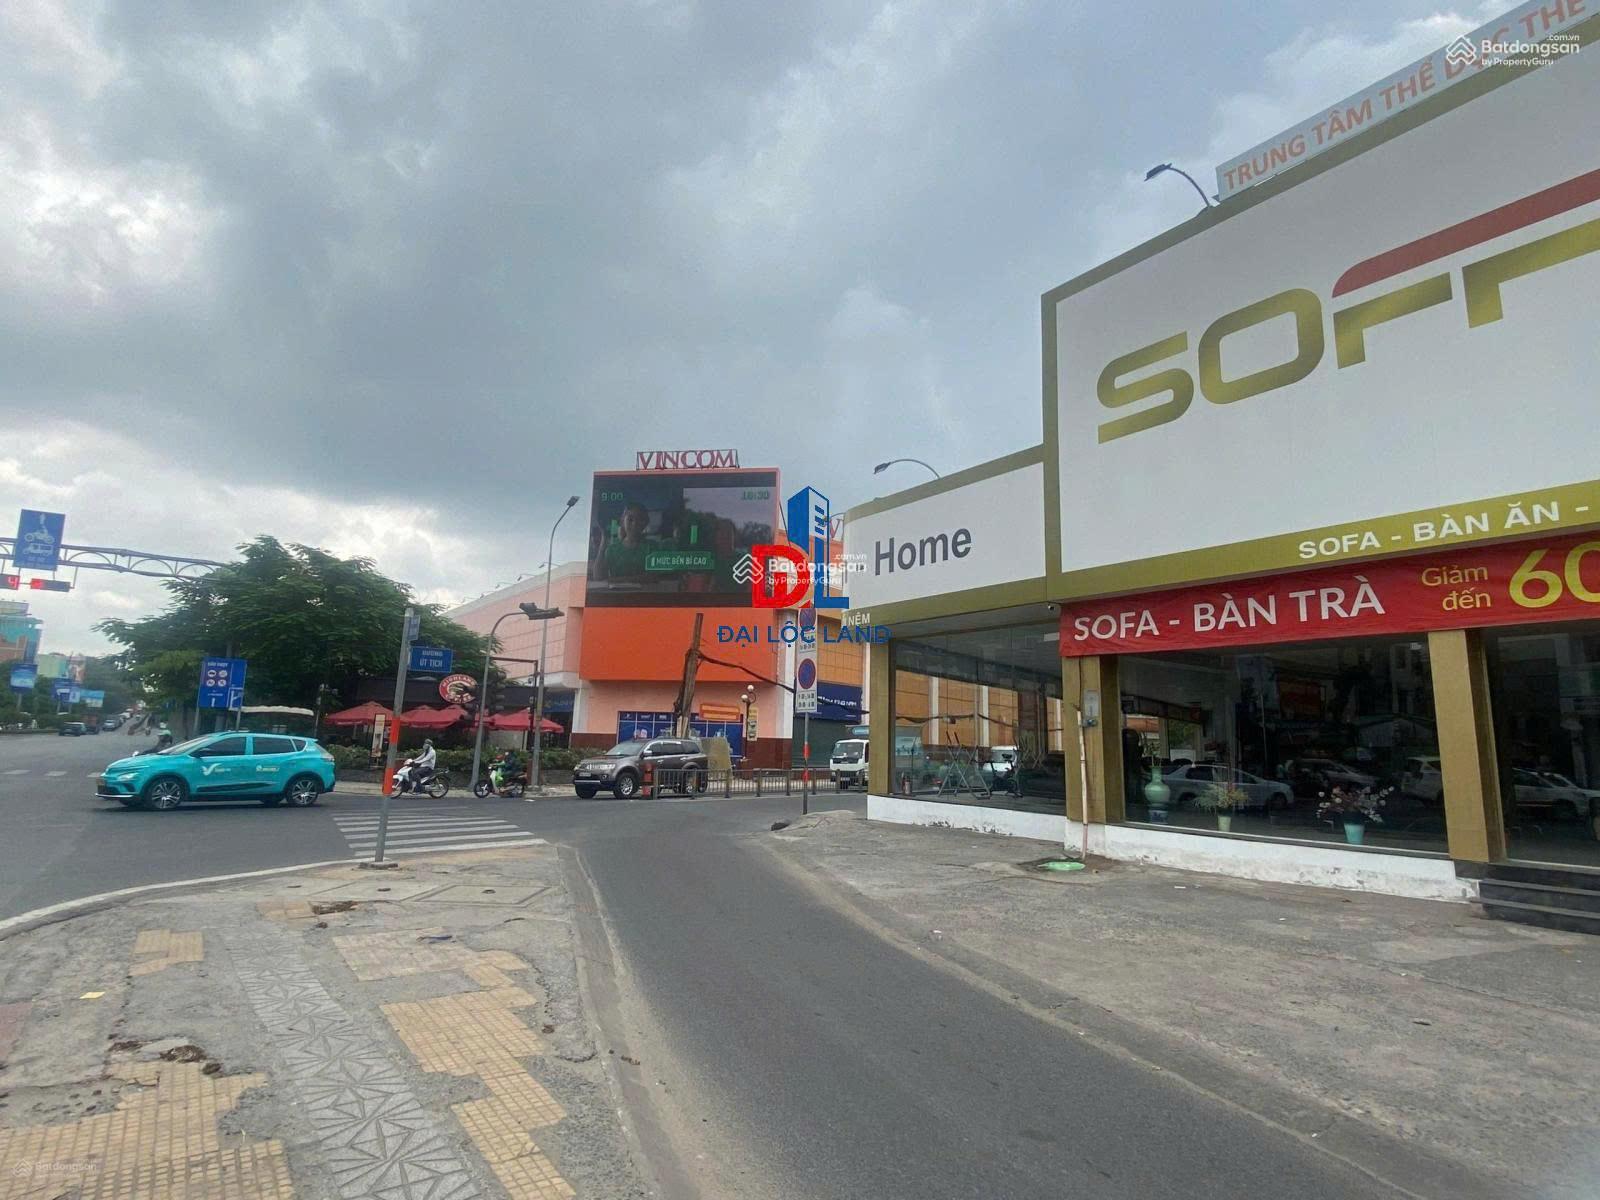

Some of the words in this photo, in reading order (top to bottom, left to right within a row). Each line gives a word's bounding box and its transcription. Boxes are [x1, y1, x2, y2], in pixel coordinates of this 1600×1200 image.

[1224, 134, 1306, 190] TRUNG
[1311, 98, 1373, 145] TÂM
[638, 449, 736, 469] VINCOM
[875, 528, 972, 576] Home
[1299, 531, 1380, 559] SOFA
[1413, 512, 1489, 542] BÀN
[1504, 501, 1560, 529] ĂN
[1421, 564, 1489, 586] Giảm
[1442, 587, 1492, 611] đến
[1074, 609, 1159, 641] SOFA
[1193, 593, 1277, 632] BÀN
[1289, 575, 1386, 622] TRÀ
